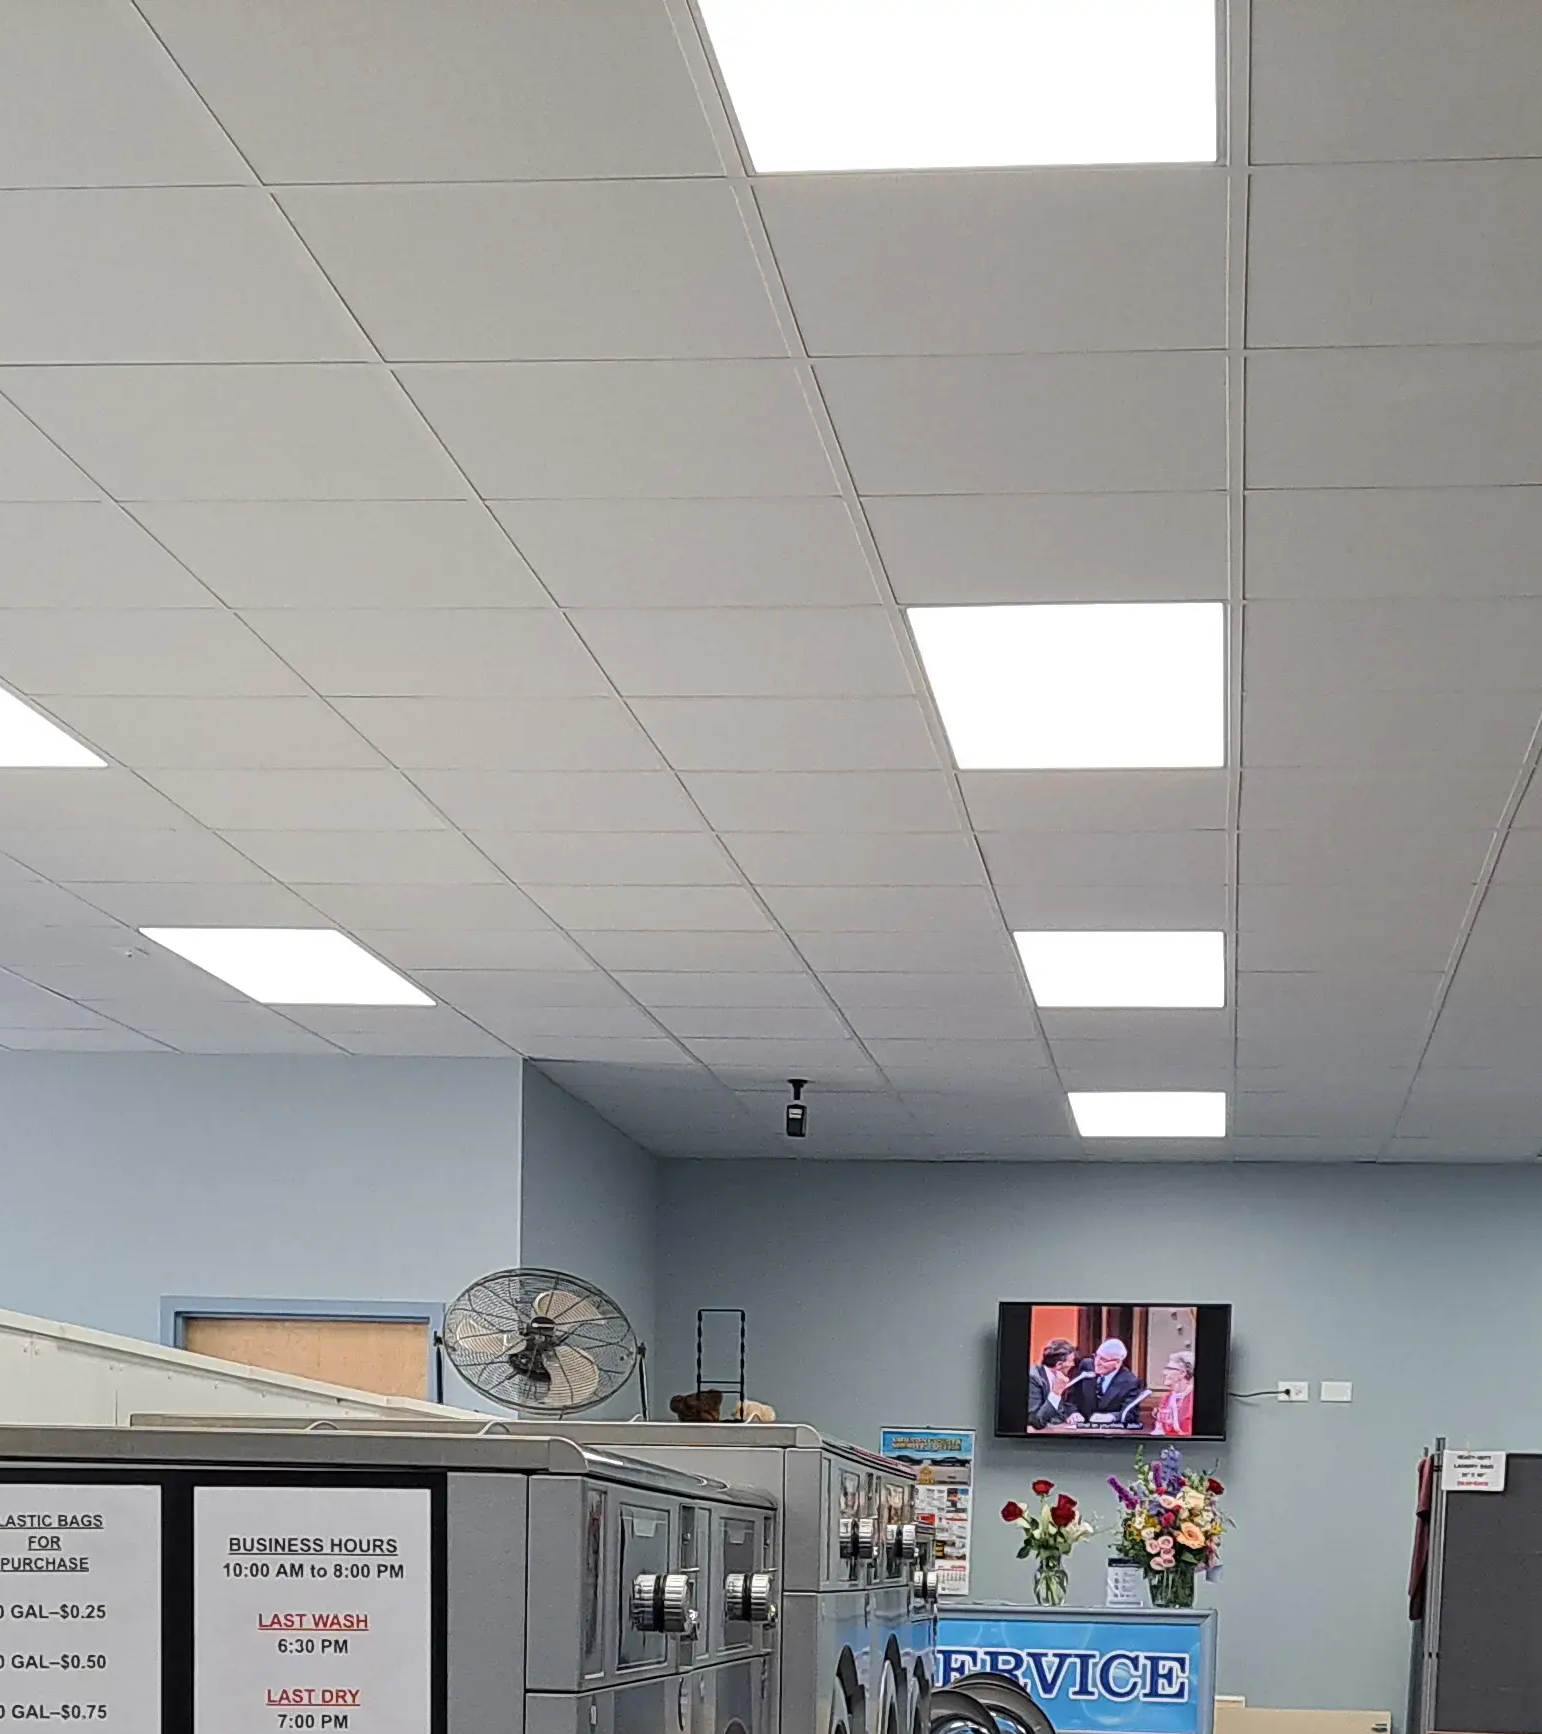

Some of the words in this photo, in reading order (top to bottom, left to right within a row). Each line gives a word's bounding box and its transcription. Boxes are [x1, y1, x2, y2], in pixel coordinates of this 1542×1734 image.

[55, 1515, 103, 1529] BAGS
[28, 1536, 61, 1551] FOR
[229, 1538, 327, 1555] BUSINESS
[327, 1538, 398, 1556] HOURS
[0, 1557, 89, 1572] PURCHASE
[223, 1563, 269, 1577] 10:00
[276, 1563, 303, 1577] AM
[310, 1565, 327, 1578] to
[334, 1564, 370, 1578] 8:00
[377, 1564, 403, 1578] PM
[258, 1614, 311, 1631] LAST
[310, 1614, 368, 1631] WASH
[278, 1639, 314, 1653] 6:30
[322, 1639, 348, 1653] PM
[266, 1689, 319, 1706] LAST
[318, 1690, 360, 1706] DRY
[278, 1714, 314, 1728] 7:00
[322, 1715, 347, 1728] PM
